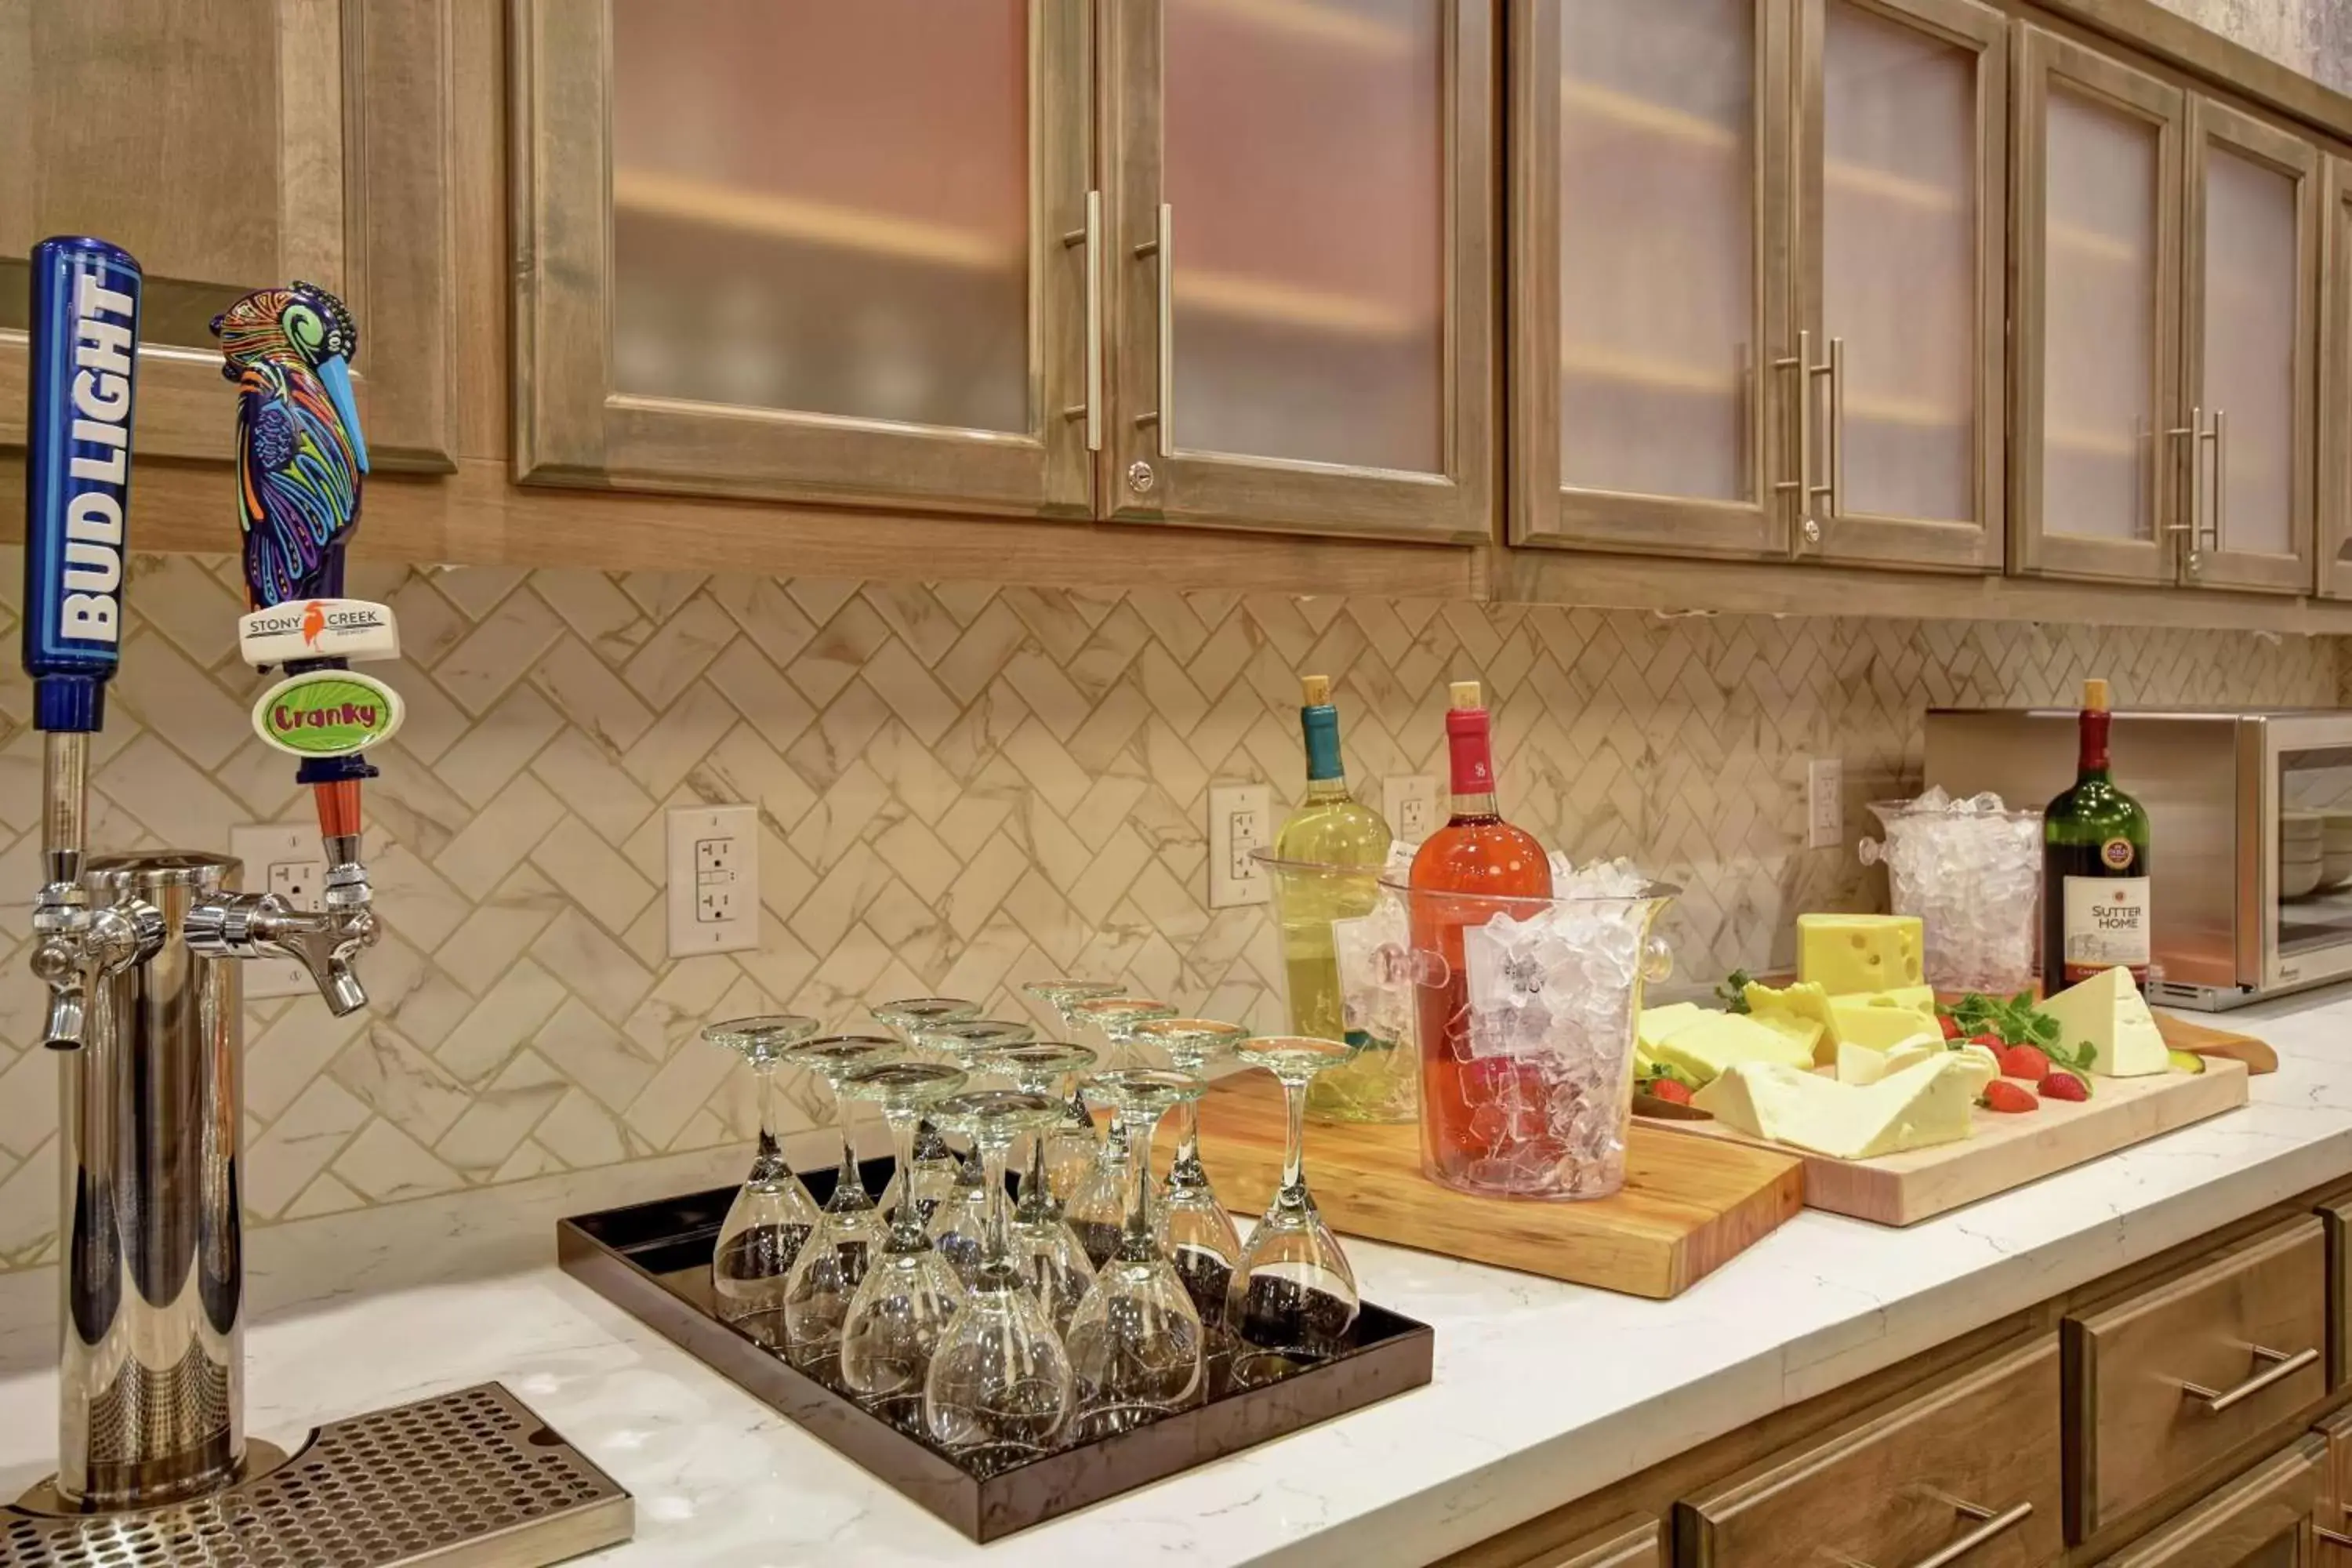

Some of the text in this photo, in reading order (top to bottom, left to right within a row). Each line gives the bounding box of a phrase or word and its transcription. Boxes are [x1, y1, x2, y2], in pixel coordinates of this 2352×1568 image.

[61, 274, 134, 642] BUD LIGHT
[250, 611, 377, 633] STONY CREEK
[275, 702, 376, 730] Cranky
[2092, 905, 2141, 917] SUTTER
[2098, 918, 2139, 929] HOME
